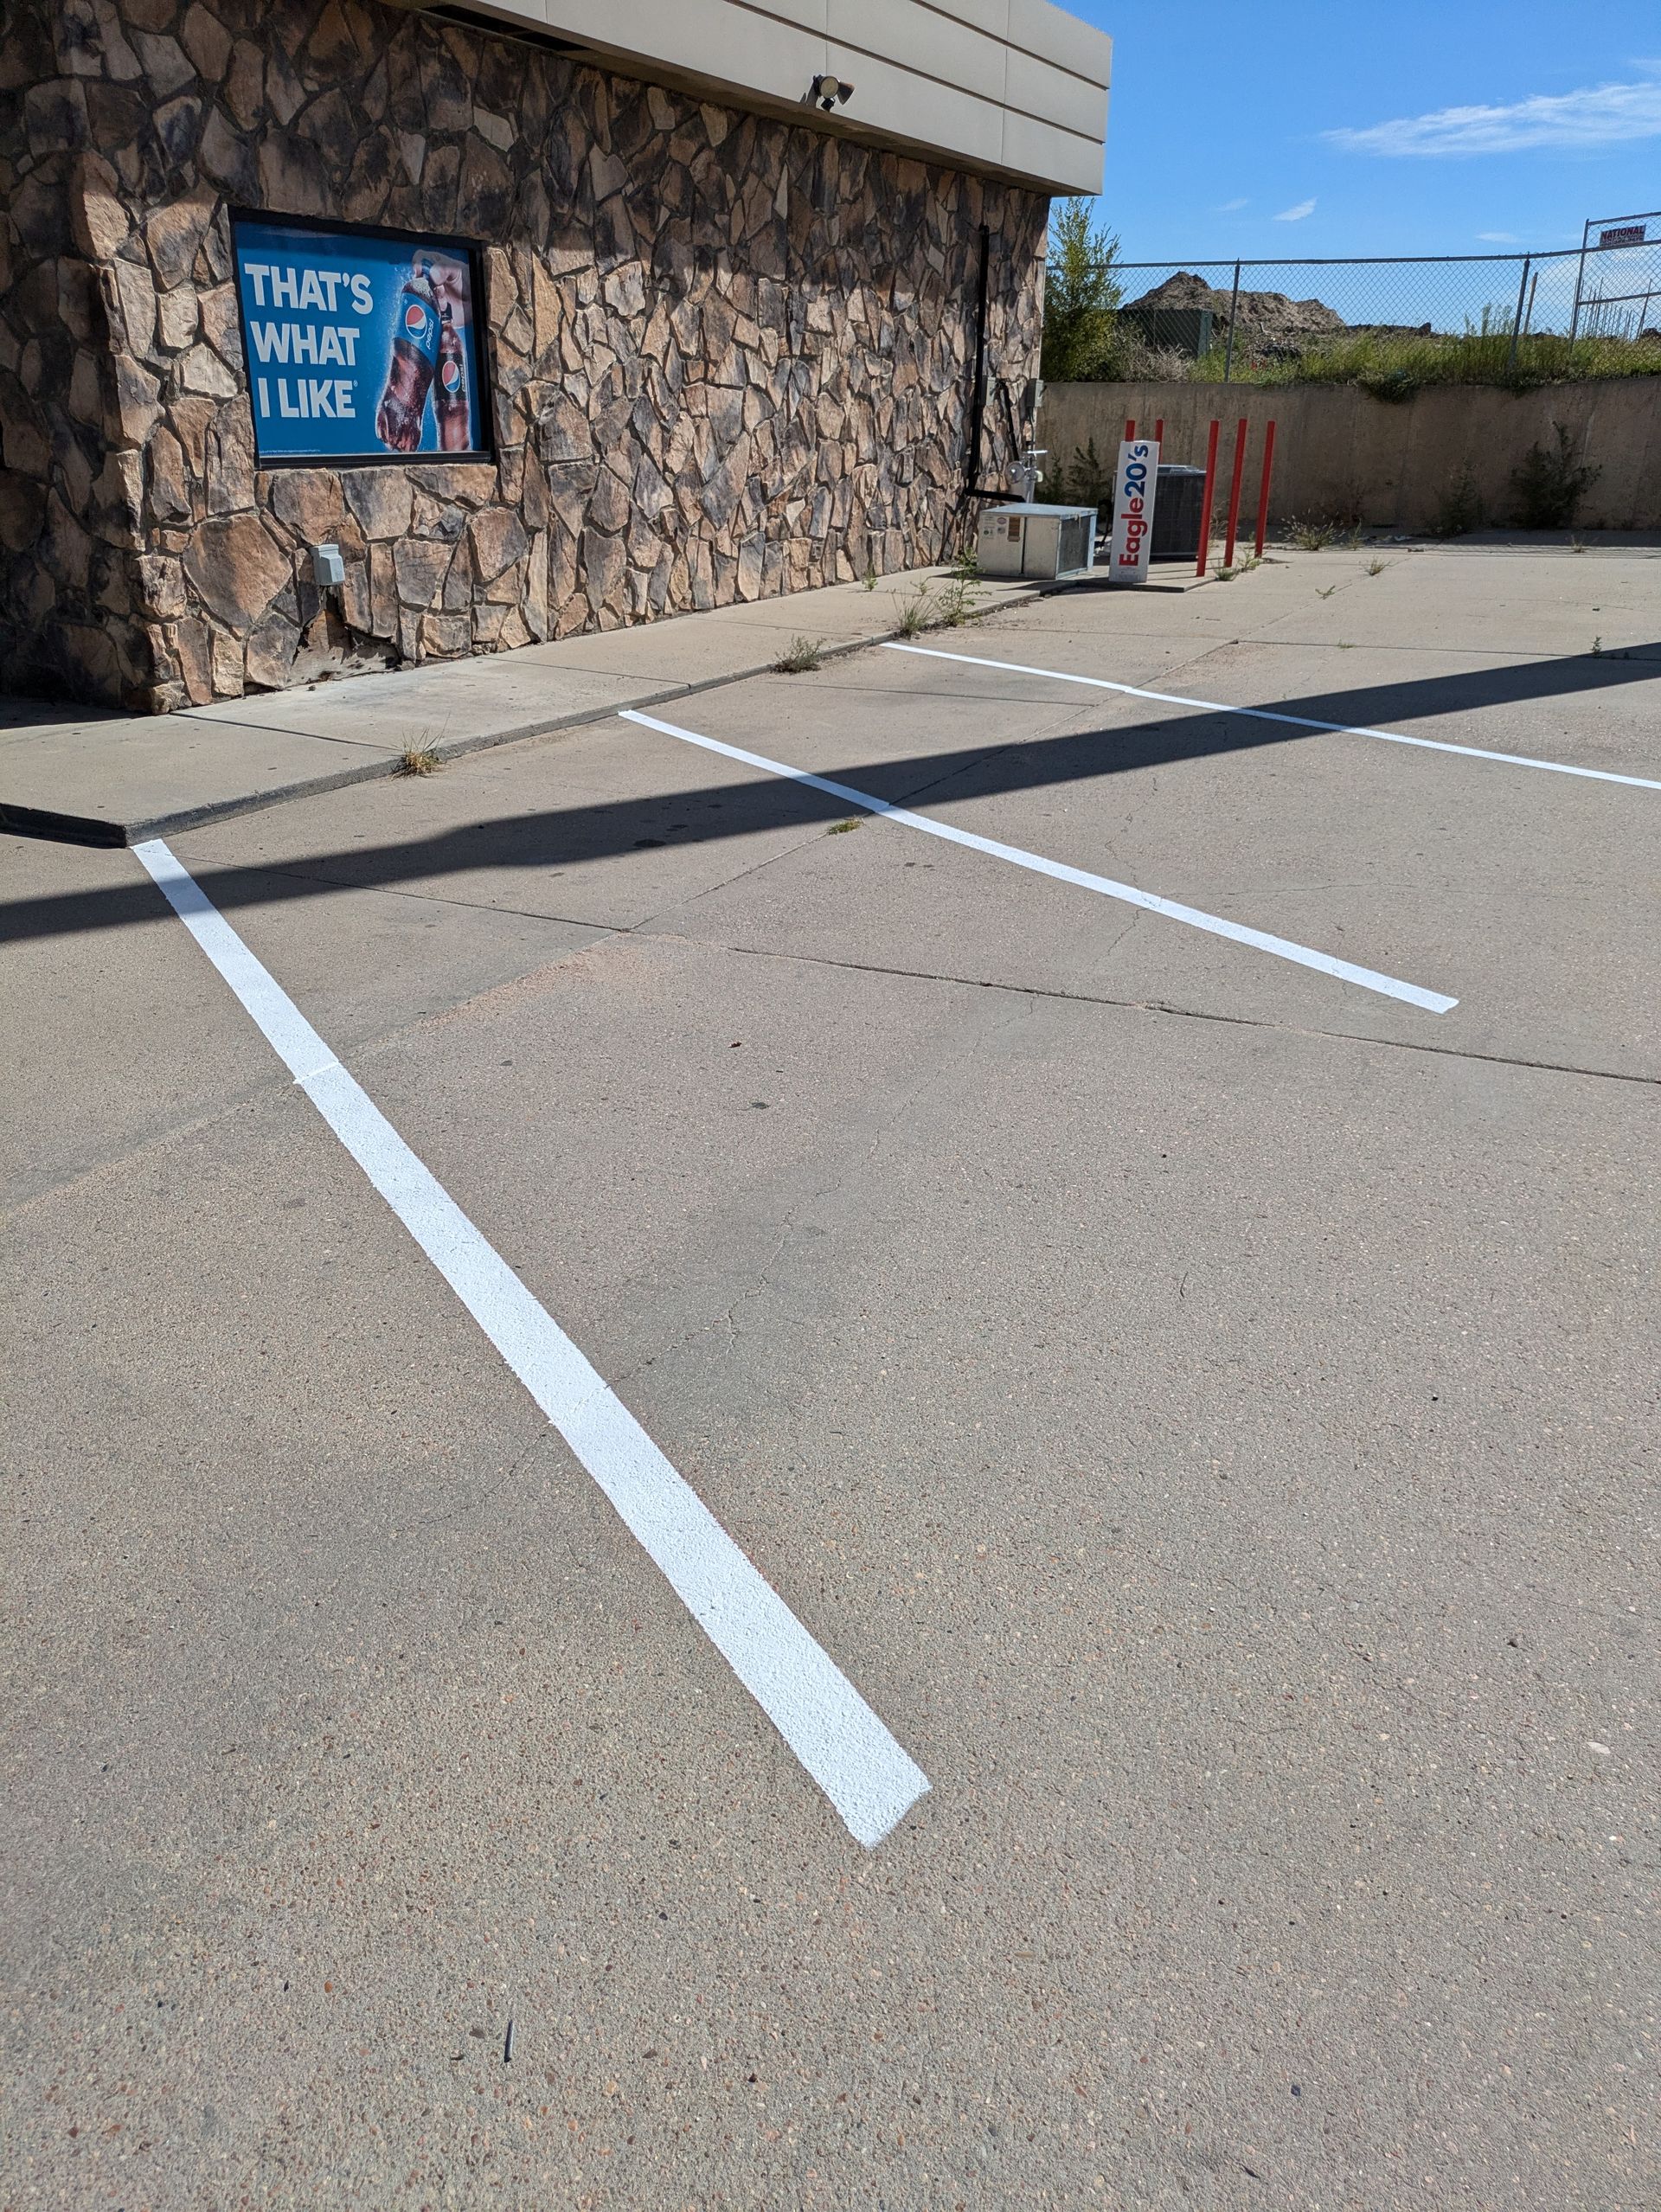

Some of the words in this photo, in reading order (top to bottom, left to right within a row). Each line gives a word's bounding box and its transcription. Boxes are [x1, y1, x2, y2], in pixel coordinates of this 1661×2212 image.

[1602, 226, 1644, 240] NATIONAL
[244, 263, 374, 315] THAT'S
[249, 321, 360, 365] WHAT
[259, 377, 271, 417] I
[1119, 445, 1149, 567] Eagle20's
